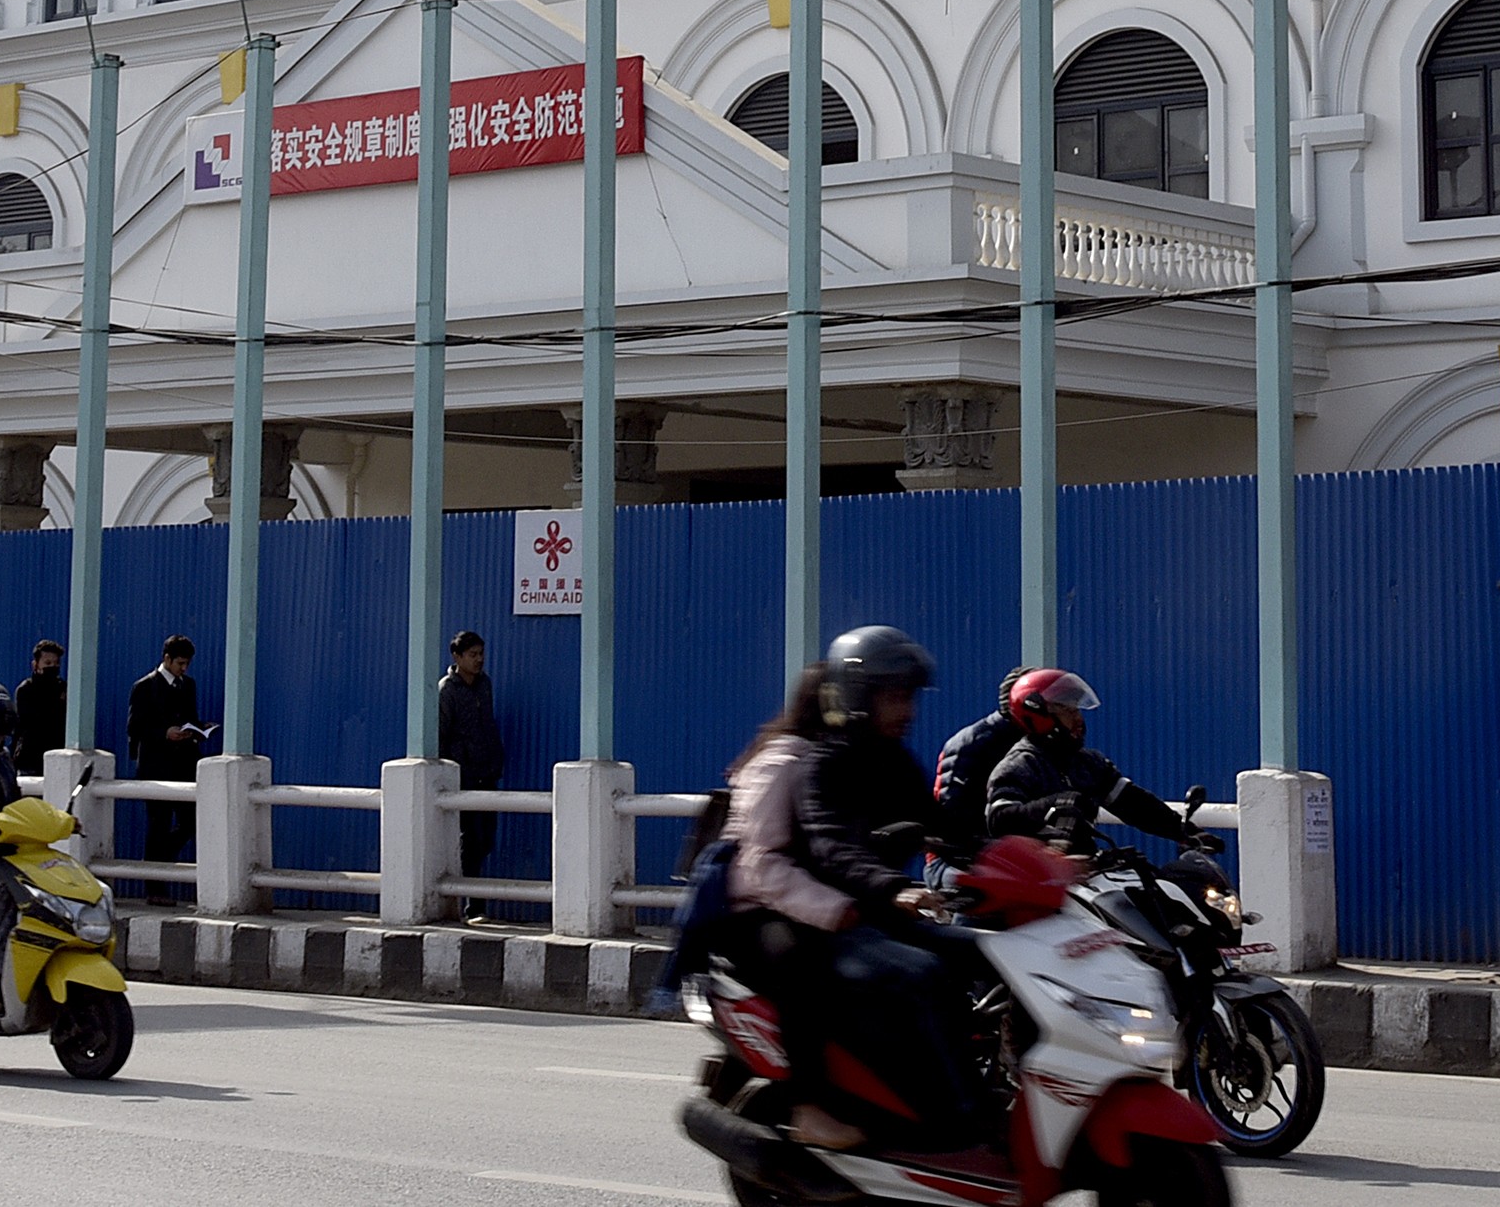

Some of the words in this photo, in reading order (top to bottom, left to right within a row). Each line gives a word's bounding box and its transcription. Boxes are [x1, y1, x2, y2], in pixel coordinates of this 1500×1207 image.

[449, 86, 624, 151] 强化安全防范
[520, 592, 558, 604] CHINA
[561, 592, 582, 604] AID
